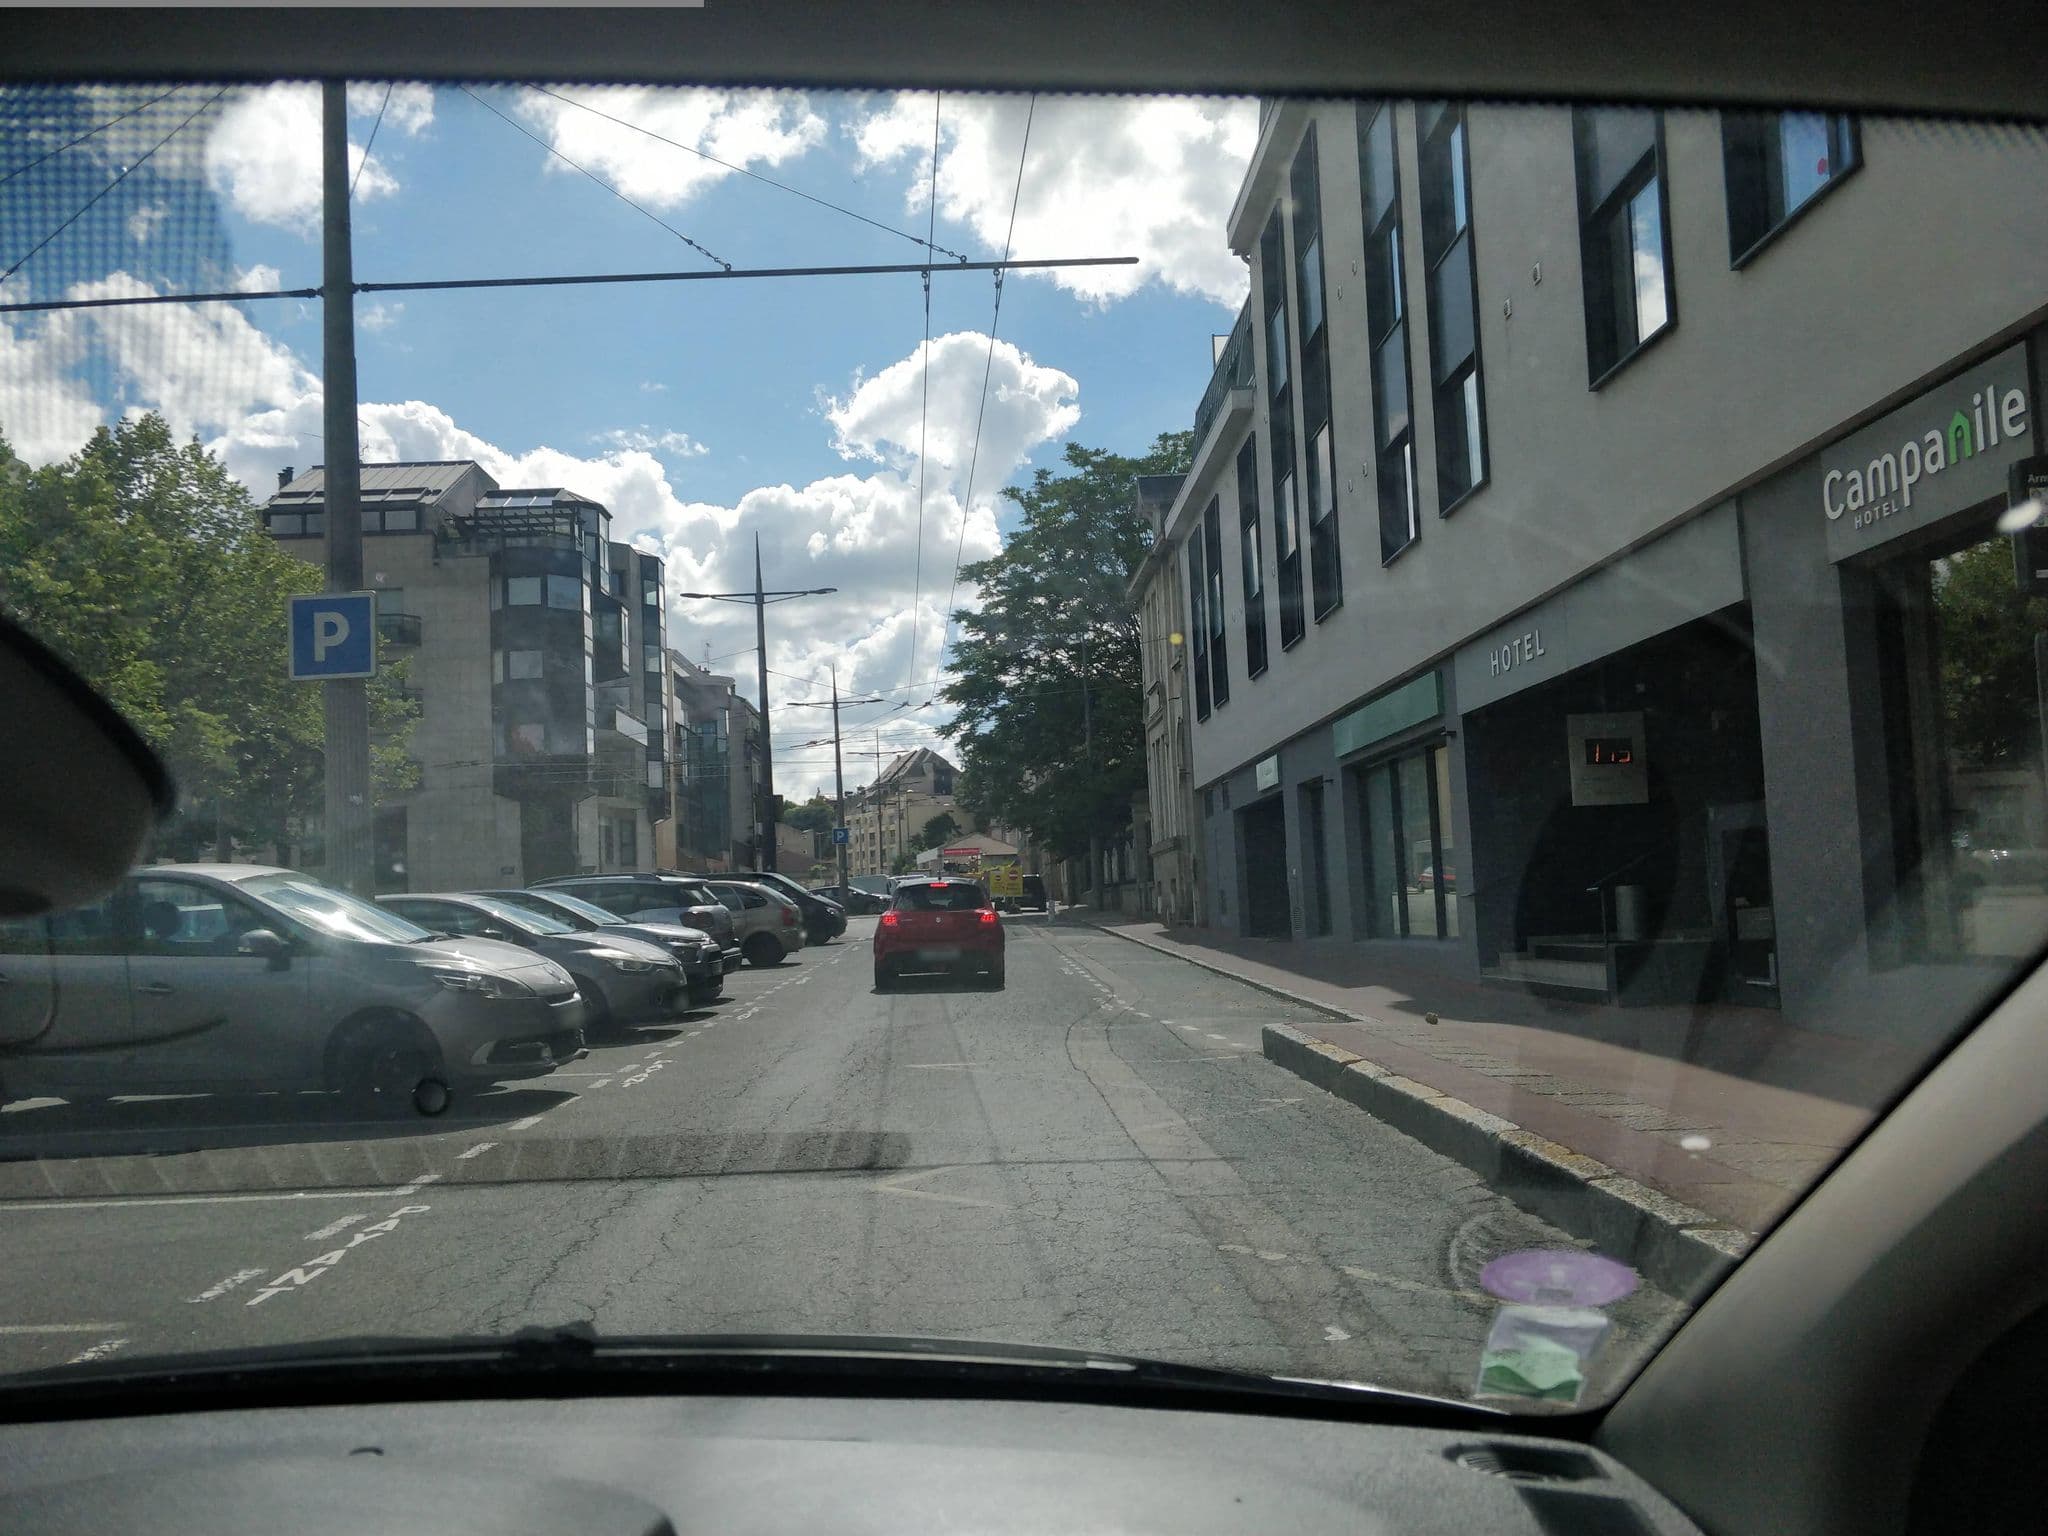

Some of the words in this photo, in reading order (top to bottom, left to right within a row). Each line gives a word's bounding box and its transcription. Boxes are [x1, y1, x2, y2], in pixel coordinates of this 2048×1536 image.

[1823, 384, 2027, 520] Campanile
[1855, 499, 1899, 529] HOTEL
[313, 611, 350, 662] P
[1490, 629, 1545, 677] HOTEL
[245, 1205, 431, 1306] PAYANT
